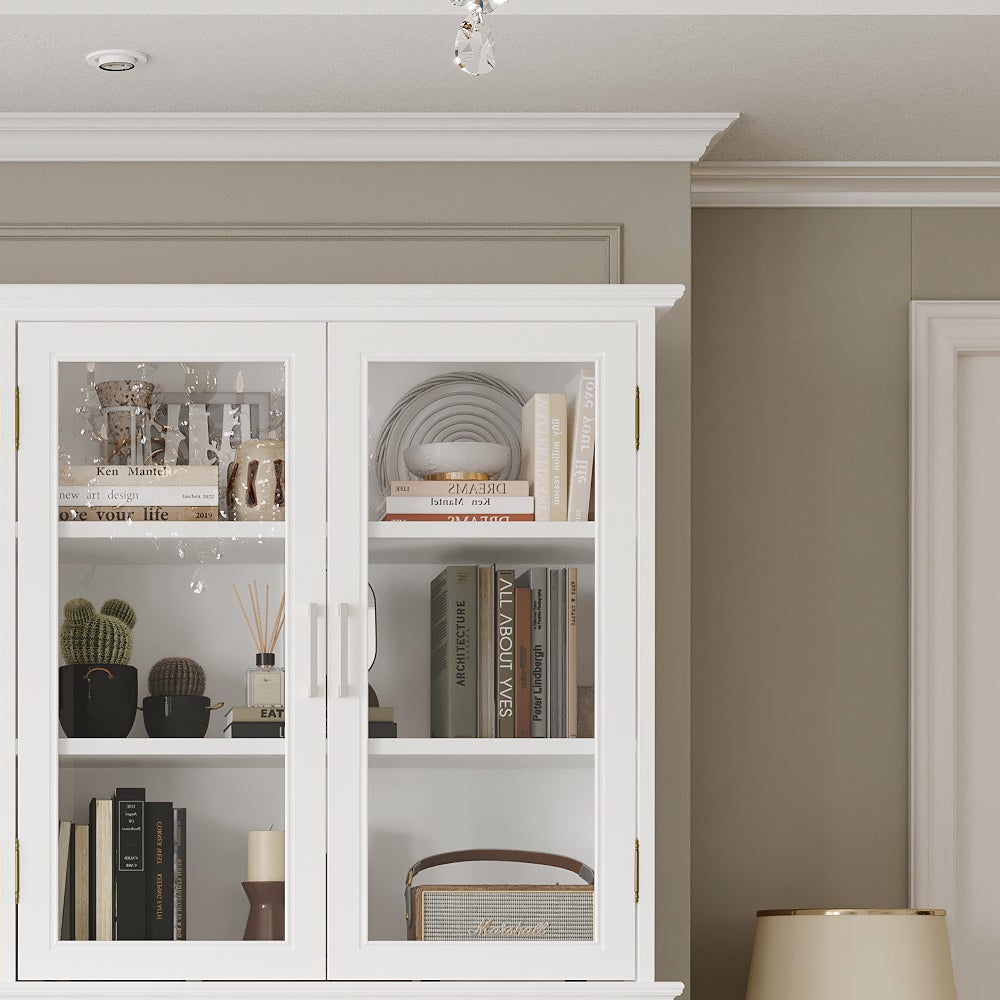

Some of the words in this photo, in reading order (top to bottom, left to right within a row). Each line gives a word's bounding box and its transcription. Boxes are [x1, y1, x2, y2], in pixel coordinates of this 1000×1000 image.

[96, 466, 119, 476] Ken
[128, 466, 167, 476] Mantel
[59, 492, 80, 500] new
[86, 491, 101, 500] art
[107, 490, 139, 502] design
[143, 507, 169, 521] life
[499, 577, 513, 609] ALL
[456, 600, 466, 687] ARCHITECTURE
[499, 613, 513, 671] ABOUT
[532, 644, 545, 694] Lindbergh
[499, 677, 513, 718] YVES
[532, 695, 543, 722] Peter
[261, 709, 284, 718] EAT
[467, 916, 550, 936] Marshall
